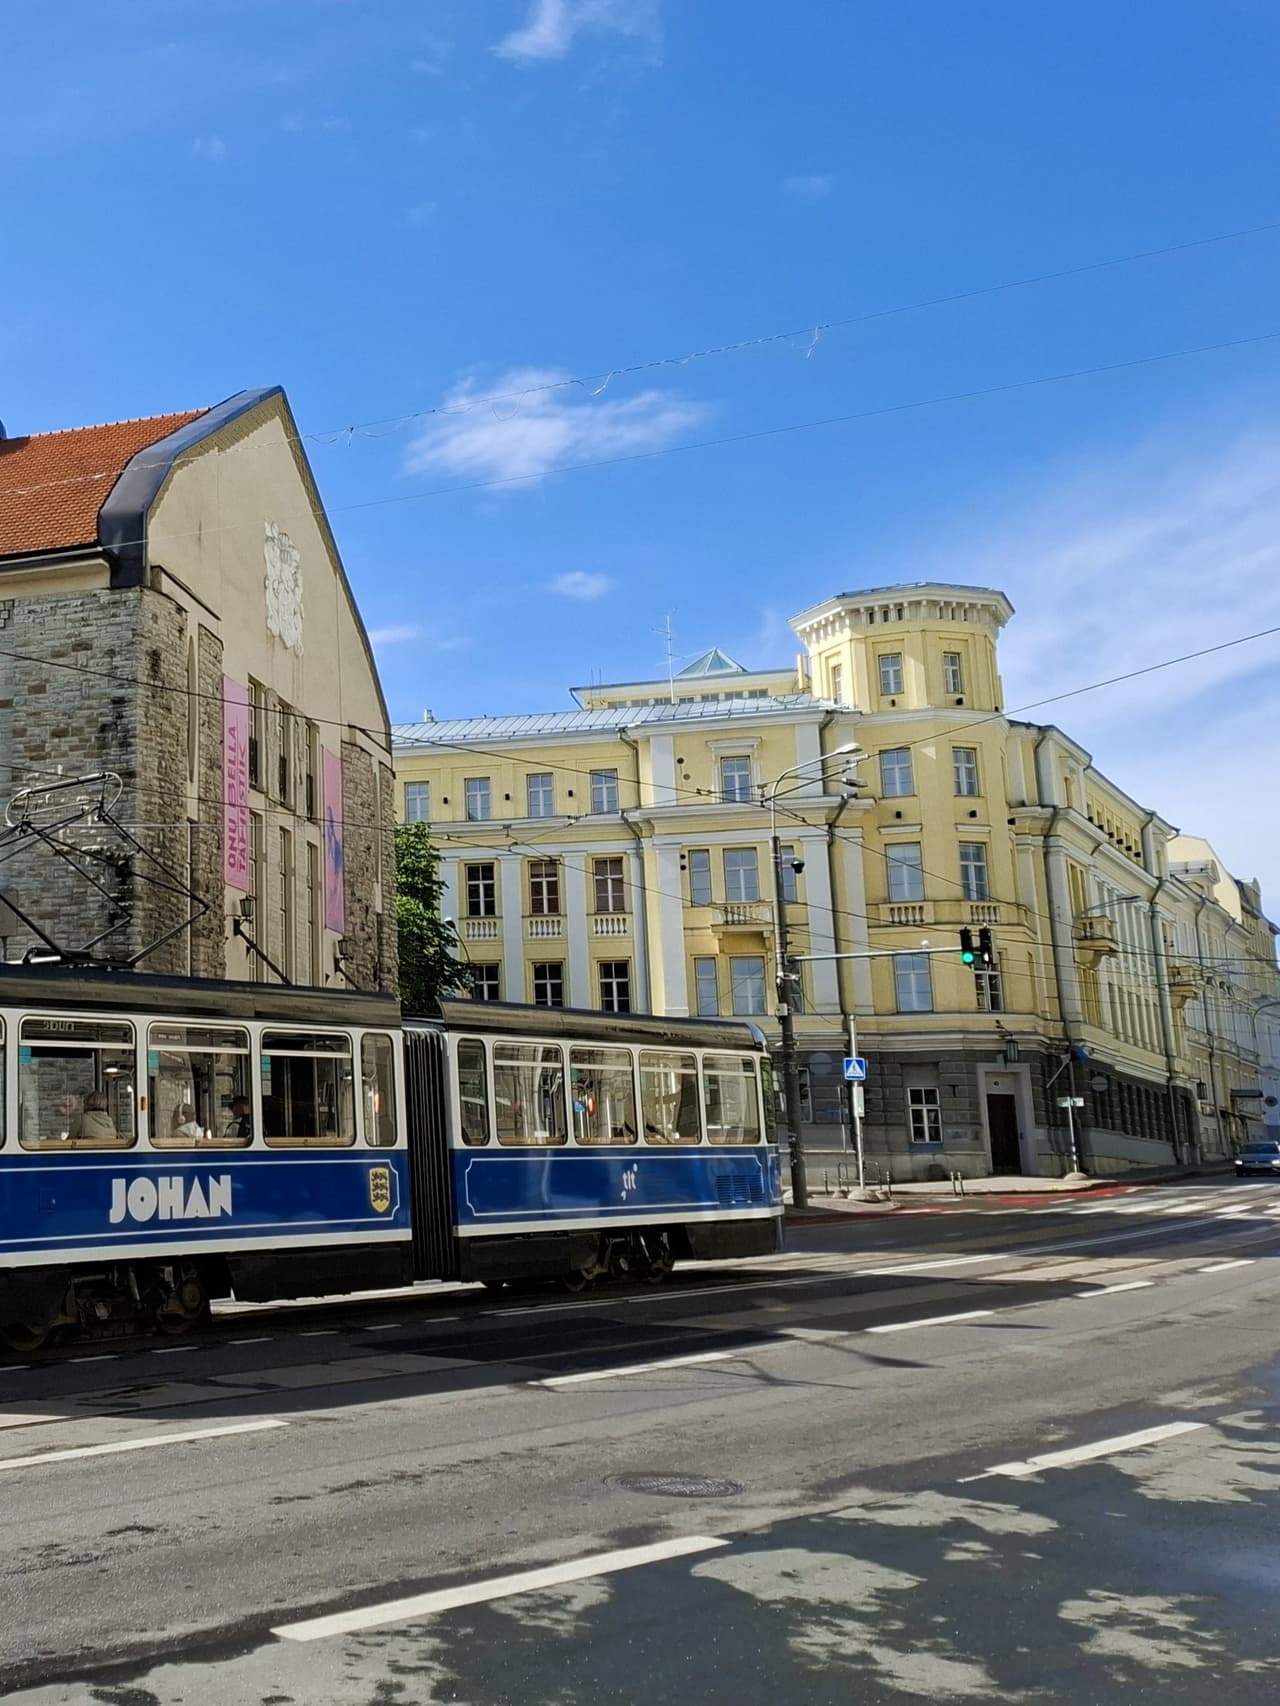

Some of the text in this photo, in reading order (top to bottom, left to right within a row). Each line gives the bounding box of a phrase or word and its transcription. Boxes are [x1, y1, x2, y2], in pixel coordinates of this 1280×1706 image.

[228, 726, 237, 868] ONU BELLA
[109, 1174, 233, 1223] JOHAN
